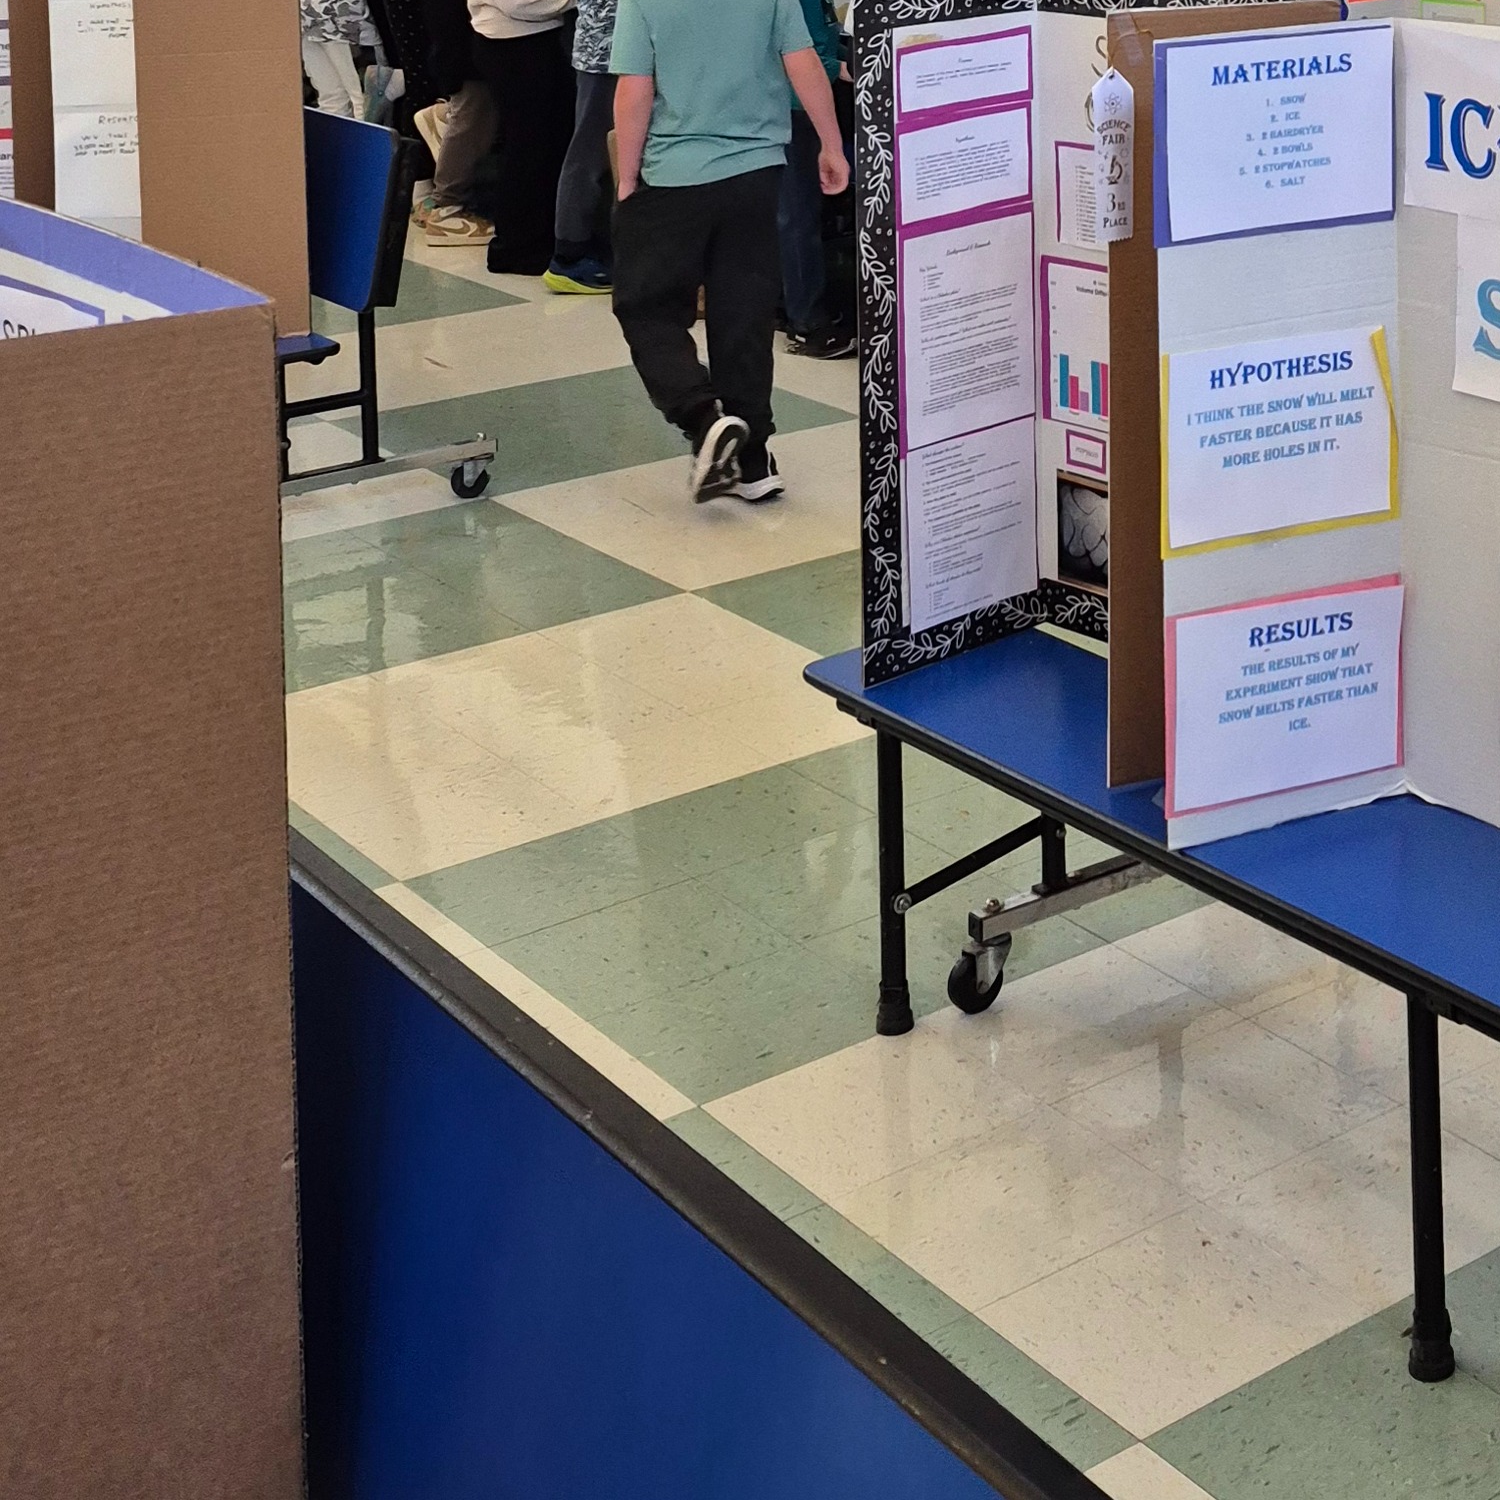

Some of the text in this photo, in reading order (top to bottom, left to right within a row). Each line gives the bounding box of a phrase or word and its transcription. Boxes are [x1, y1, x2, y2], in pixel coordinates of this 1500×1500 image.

[1211, 53, 1353, 87] MATERIALS
[1280, 93, 1307, 106] SNOW
[1285, 111, 1301, 121] ICE
[1097, 119, 1132, 134] SCIENCE
[1101, 132, 1125, 146] FAIR
[1281, 142, 1313, 155] BOWLS
[1262, 156, 1332, 173] STOPWATCHES
[1280, 175, 1306, 188] SALT
[1102, 215, 1129, 229] PLACE
[1209, 350, 1354, 390] HYPOTHESIS
[1194, 386, 1375, 424] THINK THE SNOW WILL MELT
[1199, 411, 1363, 449] FASTER BECAUSE HAS
[1222, 443, 1305, 469] MORE HOLES
[1249, 611, 1354, 648] RESULTS
